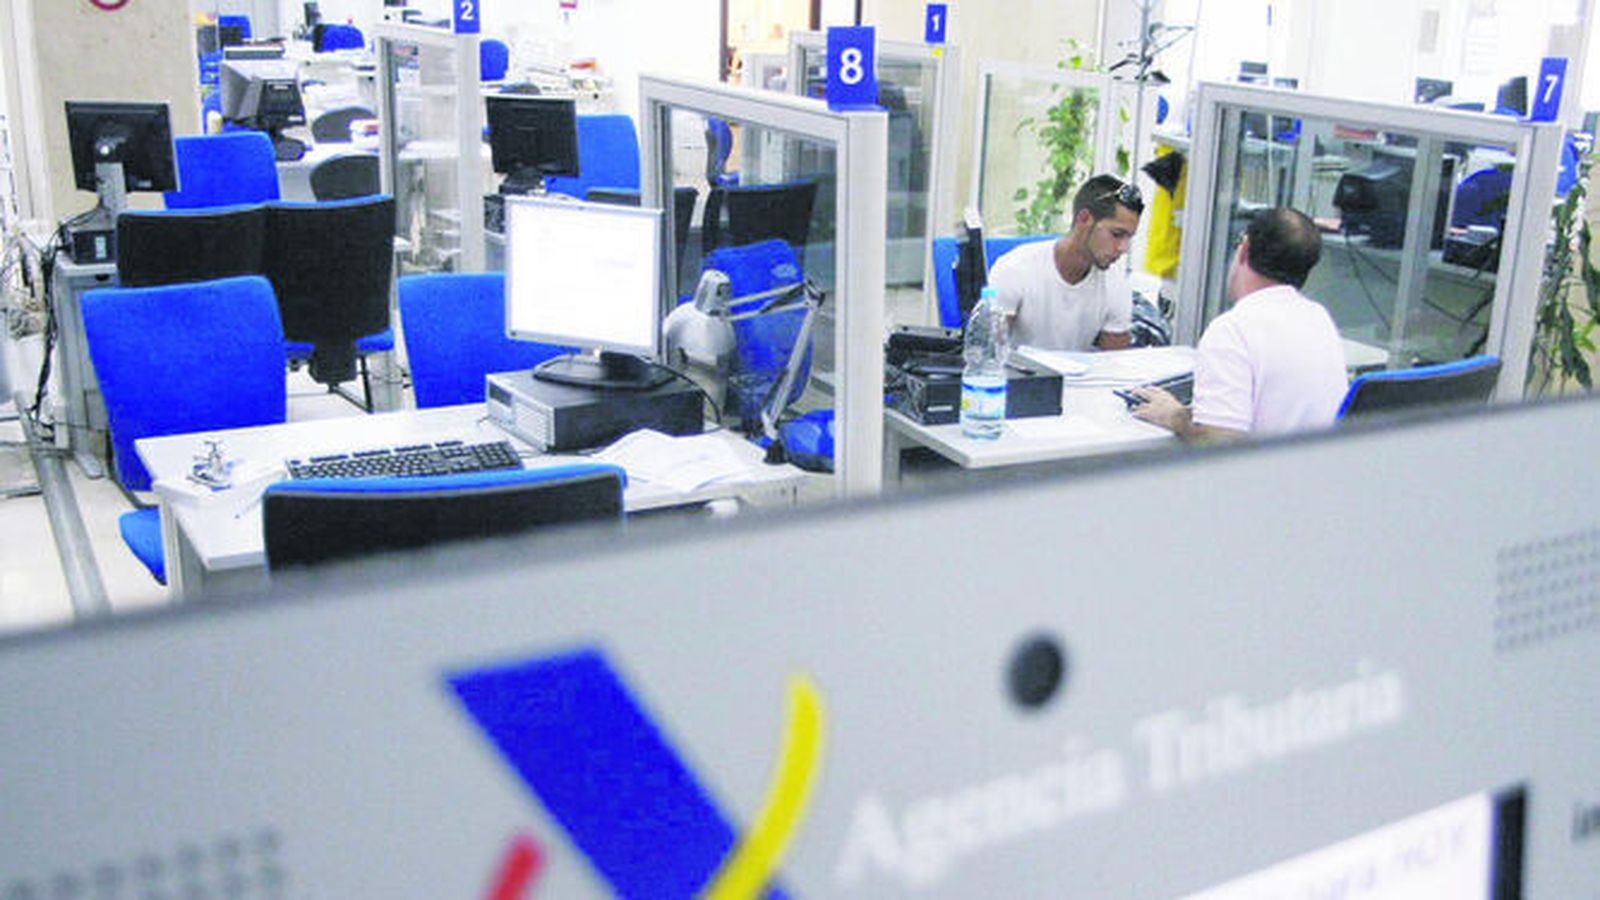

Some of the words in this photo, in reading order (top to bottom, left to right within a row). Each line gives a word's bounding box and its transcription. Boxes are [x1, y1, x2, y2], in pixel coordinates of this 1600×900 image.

[460, 1, 474, 20] 2
[931, 14, 940, 32] 1
[840, 47, 864, 85] 8
[1543, 75, 1559, 104] 7
[836, 736, 1126, 888] Agencia
[1133, 658, 1405, 793] Tributaria
